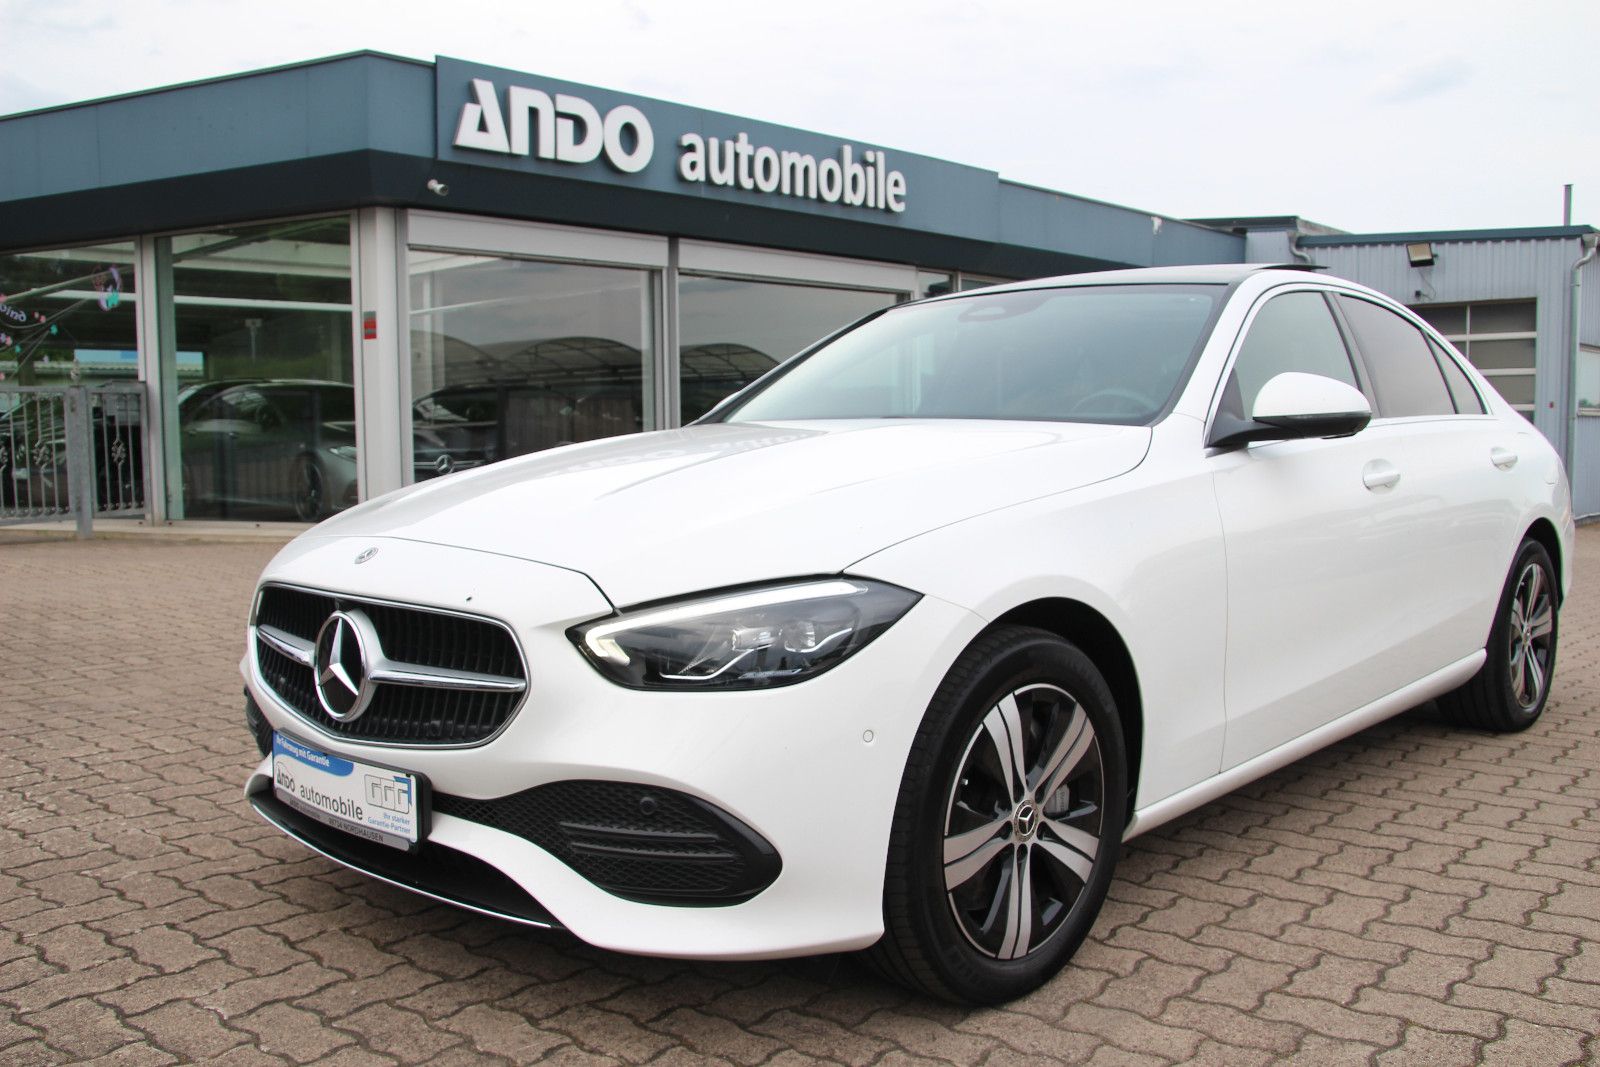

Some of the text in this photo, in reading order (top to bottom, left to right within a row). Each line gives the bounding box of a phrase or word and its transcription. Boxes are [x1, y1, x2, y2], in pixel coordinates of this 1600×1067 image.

[454, 78, 906, 213] ANDO automobile
[307, 751, 330, 767] Garantie
[300, 784, 363, 820] automobile
[344, 821, 384, 842] NORDHAUSEN
